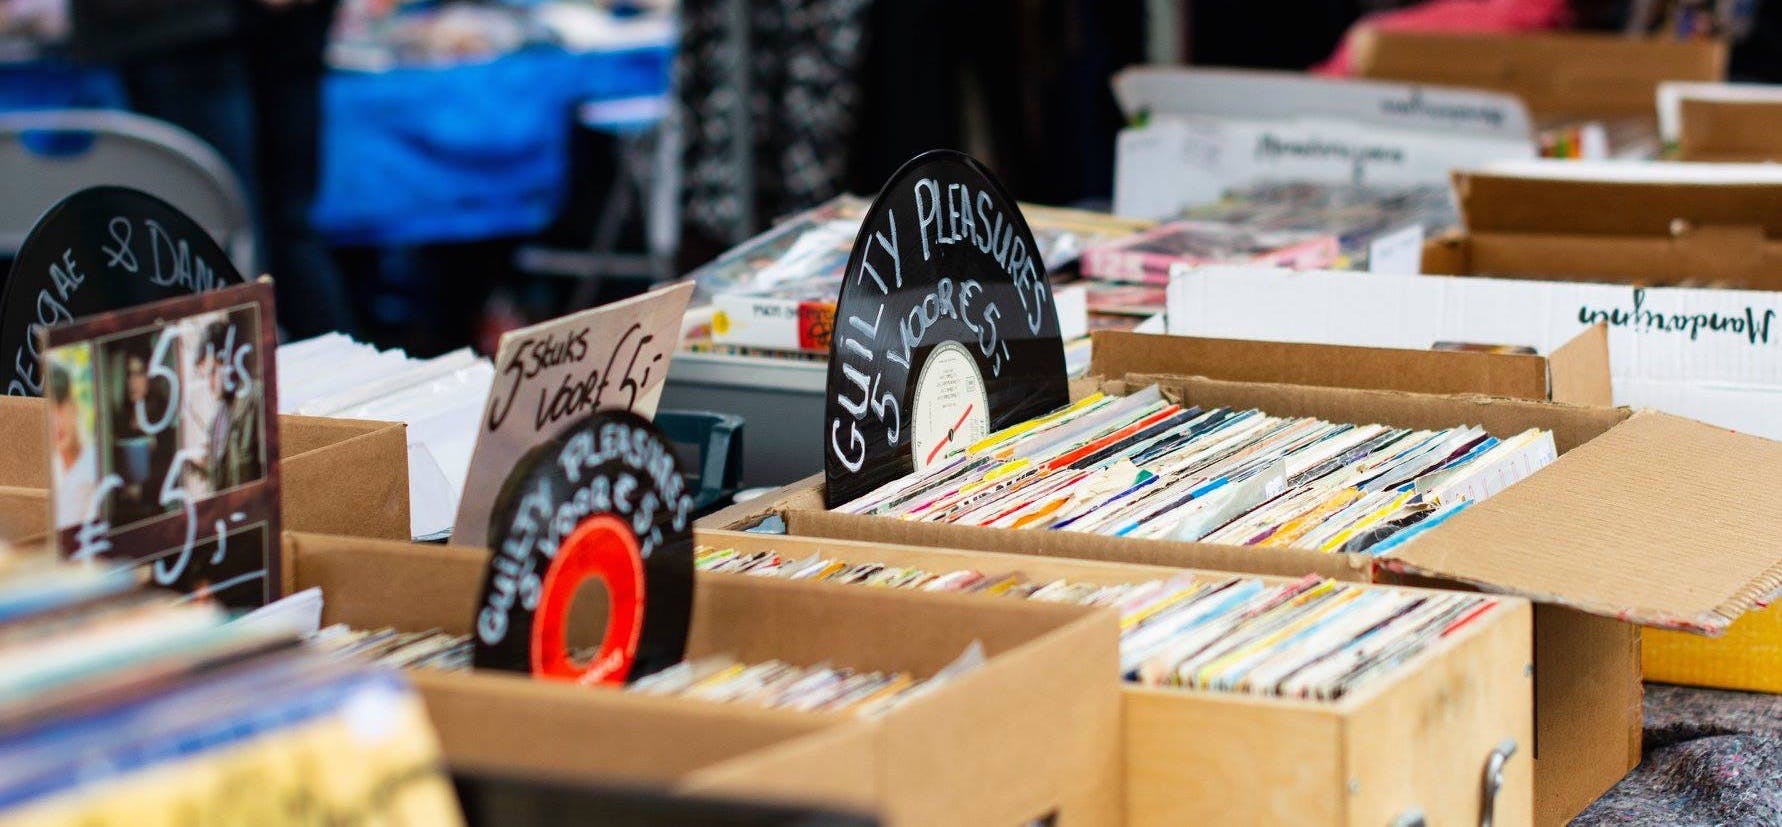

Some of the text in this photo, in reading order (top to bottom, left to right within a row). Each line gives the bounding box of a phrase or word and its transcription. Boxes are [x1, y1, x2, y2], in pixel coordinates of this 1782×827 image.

[102, 216, 139, 273] &
[913, 177, 1047, 337] PLEASURES
[488, 338, 535, 432] 5
[870, 372, 900, 447] 5
[886, 277, 958, 370] VOOR
[558, 422, 694, 532] PLEASURES
[518, 555, 544, 611] 5
